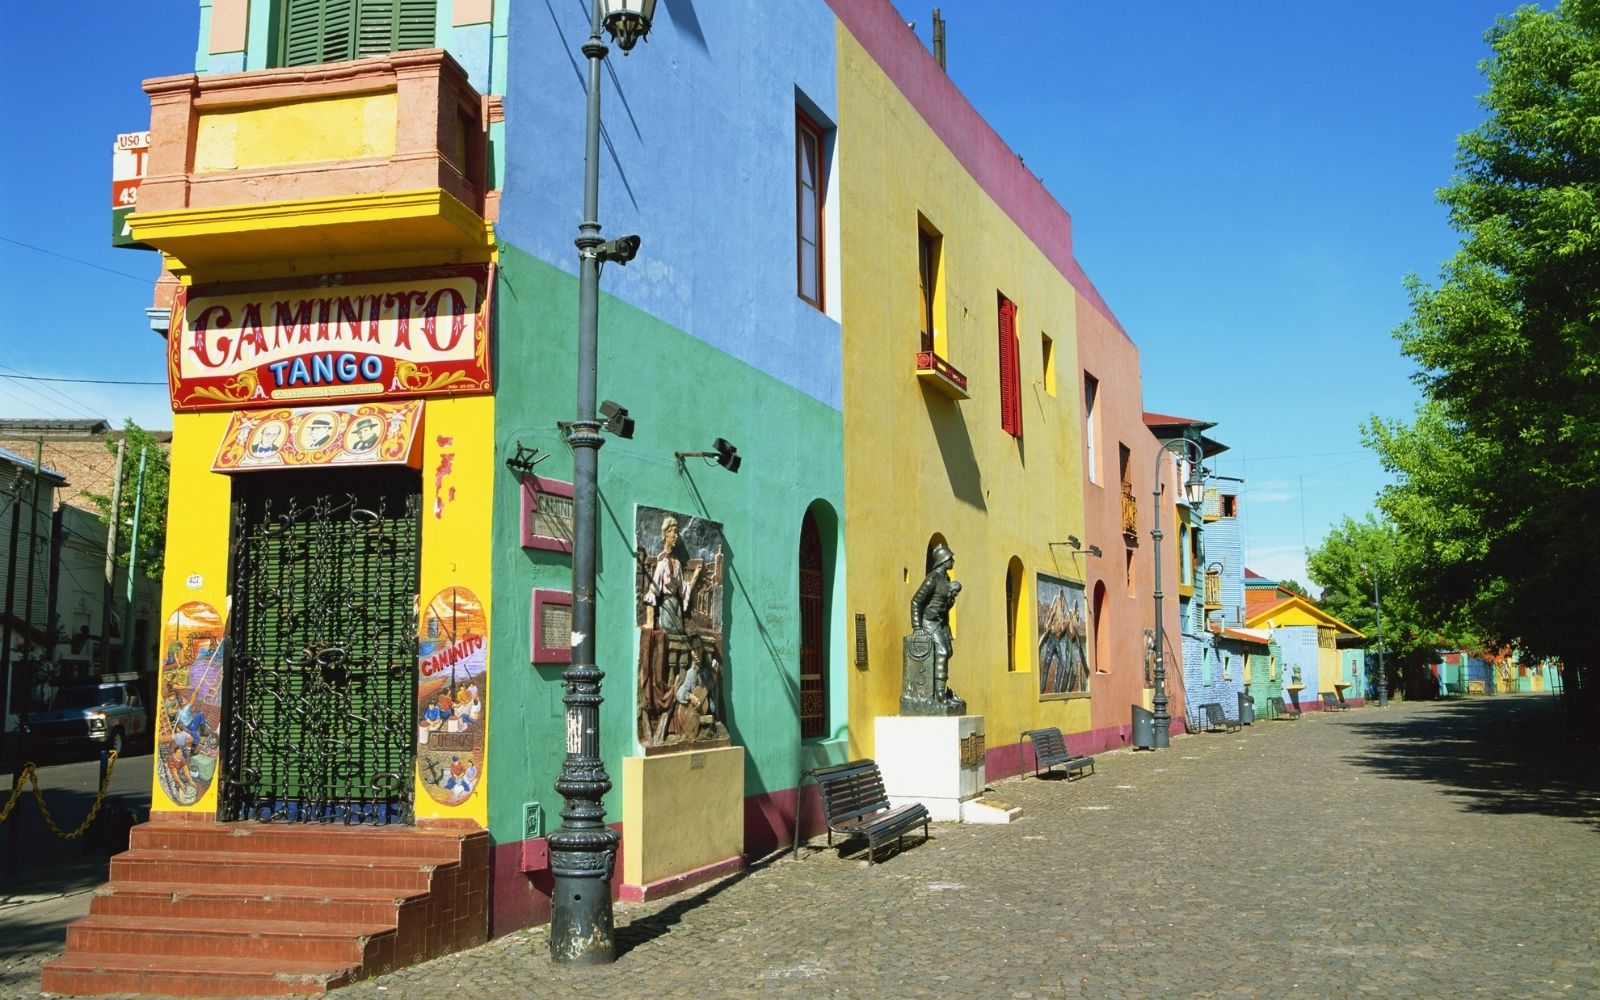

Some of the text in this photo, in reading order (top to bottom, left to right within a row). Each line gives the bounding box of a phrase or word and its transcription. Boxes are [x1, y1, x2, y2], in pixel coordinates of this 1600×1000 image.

[120, 135, 140, 148] USO
[188, 287, 468, 368] CAMINITO
[270, 354, 382, 386] TANGO
[537, 495, 574, 518] CAMINIT
[421, 634, 482, 677] CAMINITO
